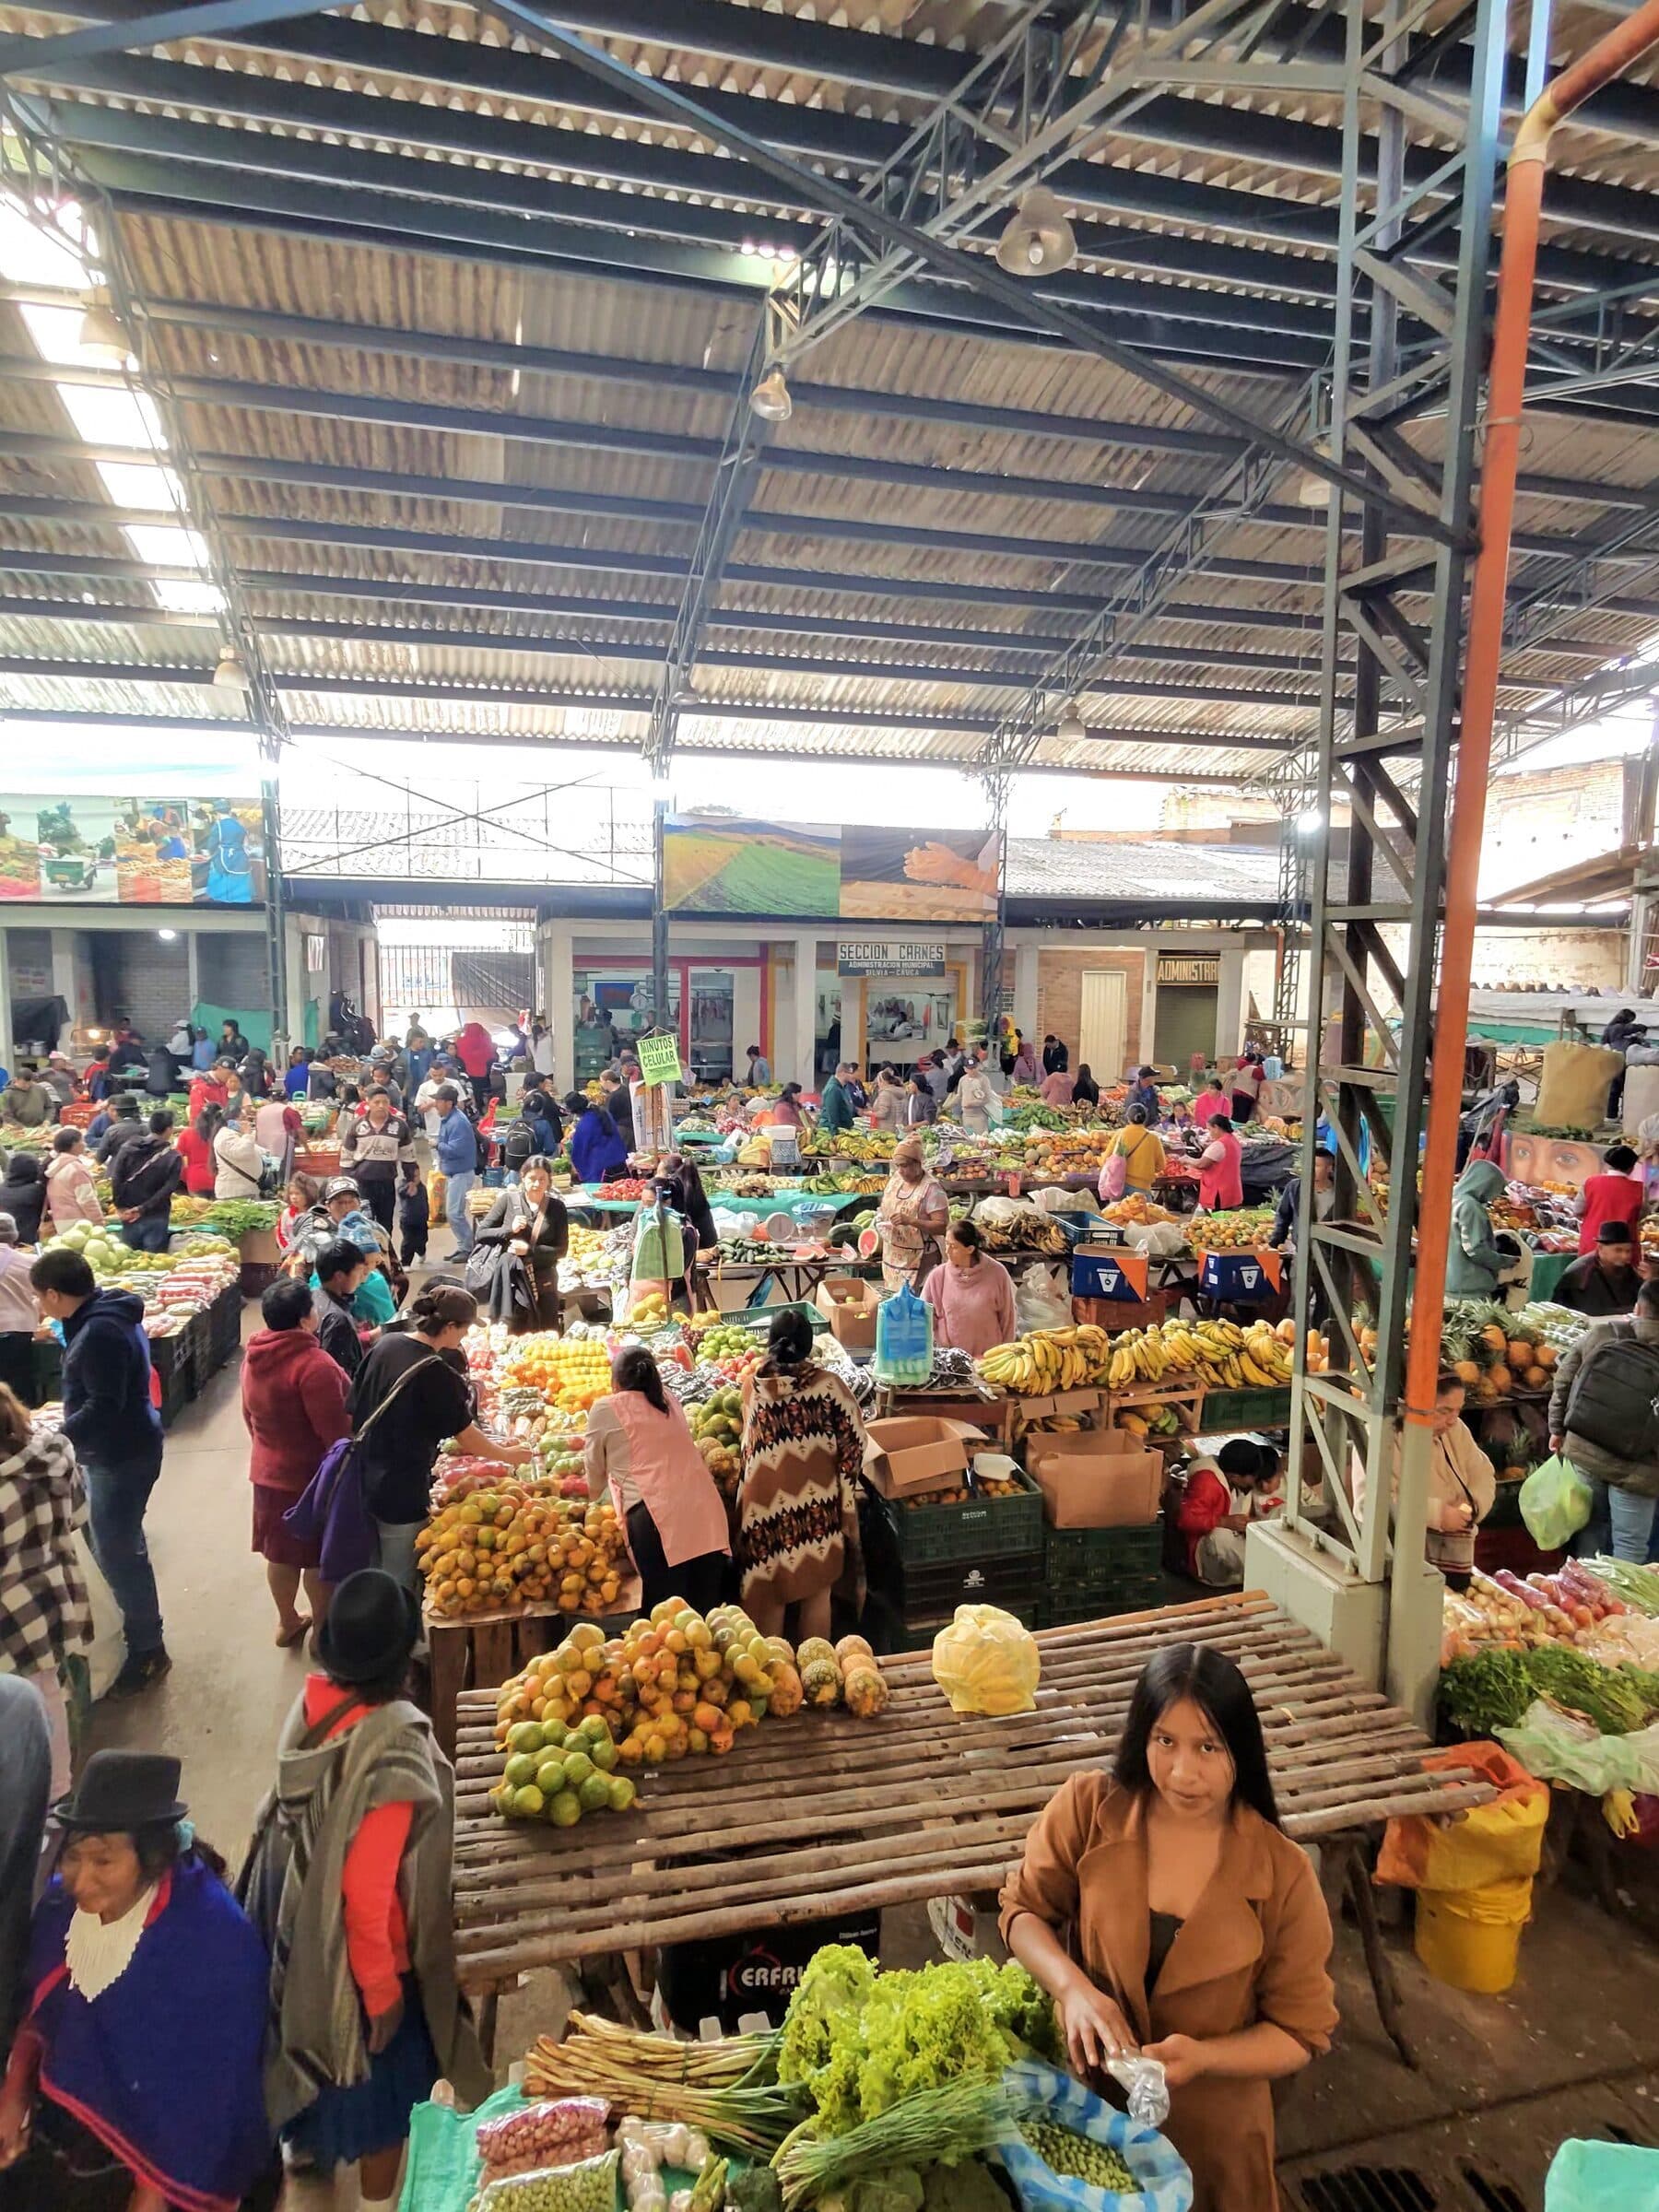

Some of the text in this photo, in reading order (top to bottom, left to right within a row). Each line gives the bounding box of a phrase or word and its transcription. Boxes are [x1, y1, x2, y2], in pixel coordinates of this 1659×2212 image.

[840, 944, 944, 960] SECCION CARNES
[640, 1037, 673, 1053] MINUTOS
[642, 1051, 676, 1067] CELULAR
